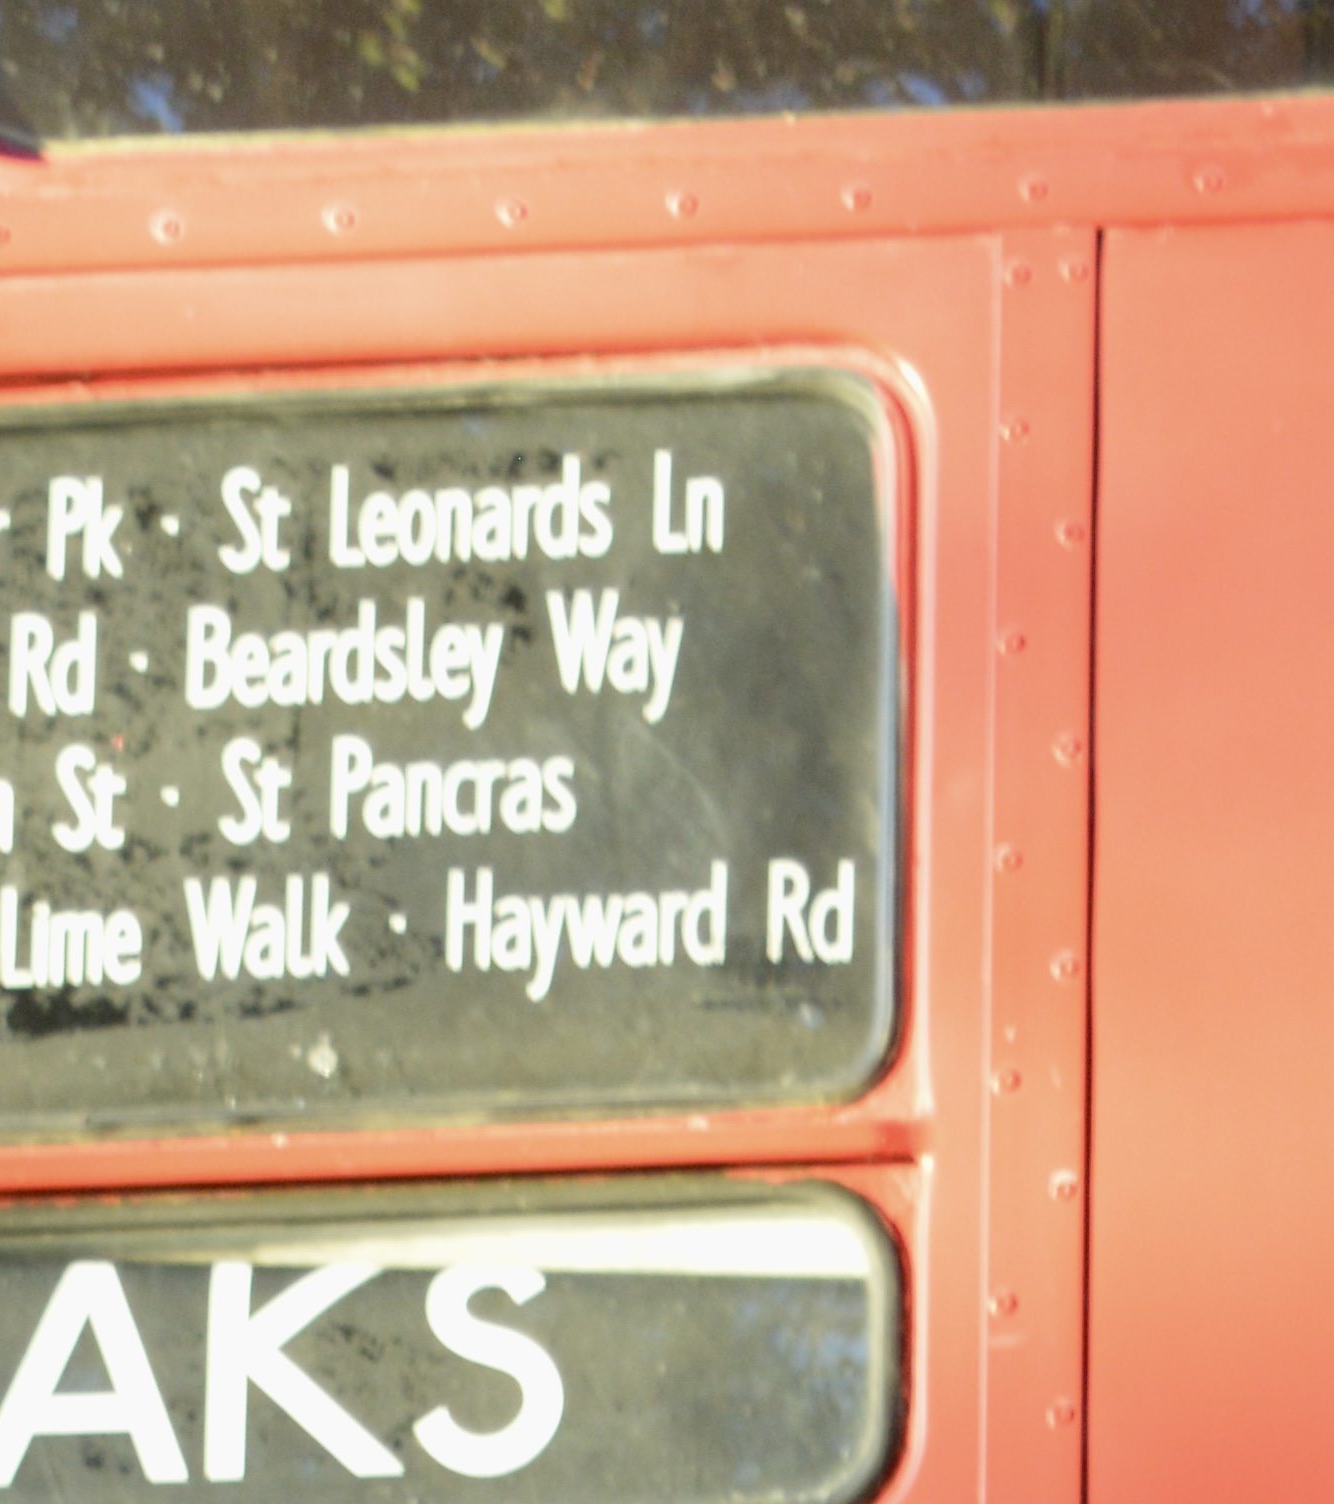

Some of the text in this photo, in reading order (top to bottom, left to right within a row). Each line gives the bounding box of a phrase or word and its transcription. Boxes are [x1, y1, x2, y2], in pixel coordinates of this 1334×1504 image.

[45, 474, 126, 583] Pk
[216, 464, 294, 576] St
[327, 451, 615, 569] Leonards
[650, 447, 726, 555] Ln
[6, 609, 99, 719] Rd
[183, 594, 506, 732] Beardsley
[544, 586, 685, 725] Way
[50, 741, 129, 854] St
[216, 734, 294, 847] St
[328, 732, 579, 841] Pancras
[181, 871, 352, 983] Walk
[444, 858, 730, 1004] Hayward
[765, 857, 857, 965] Rd
